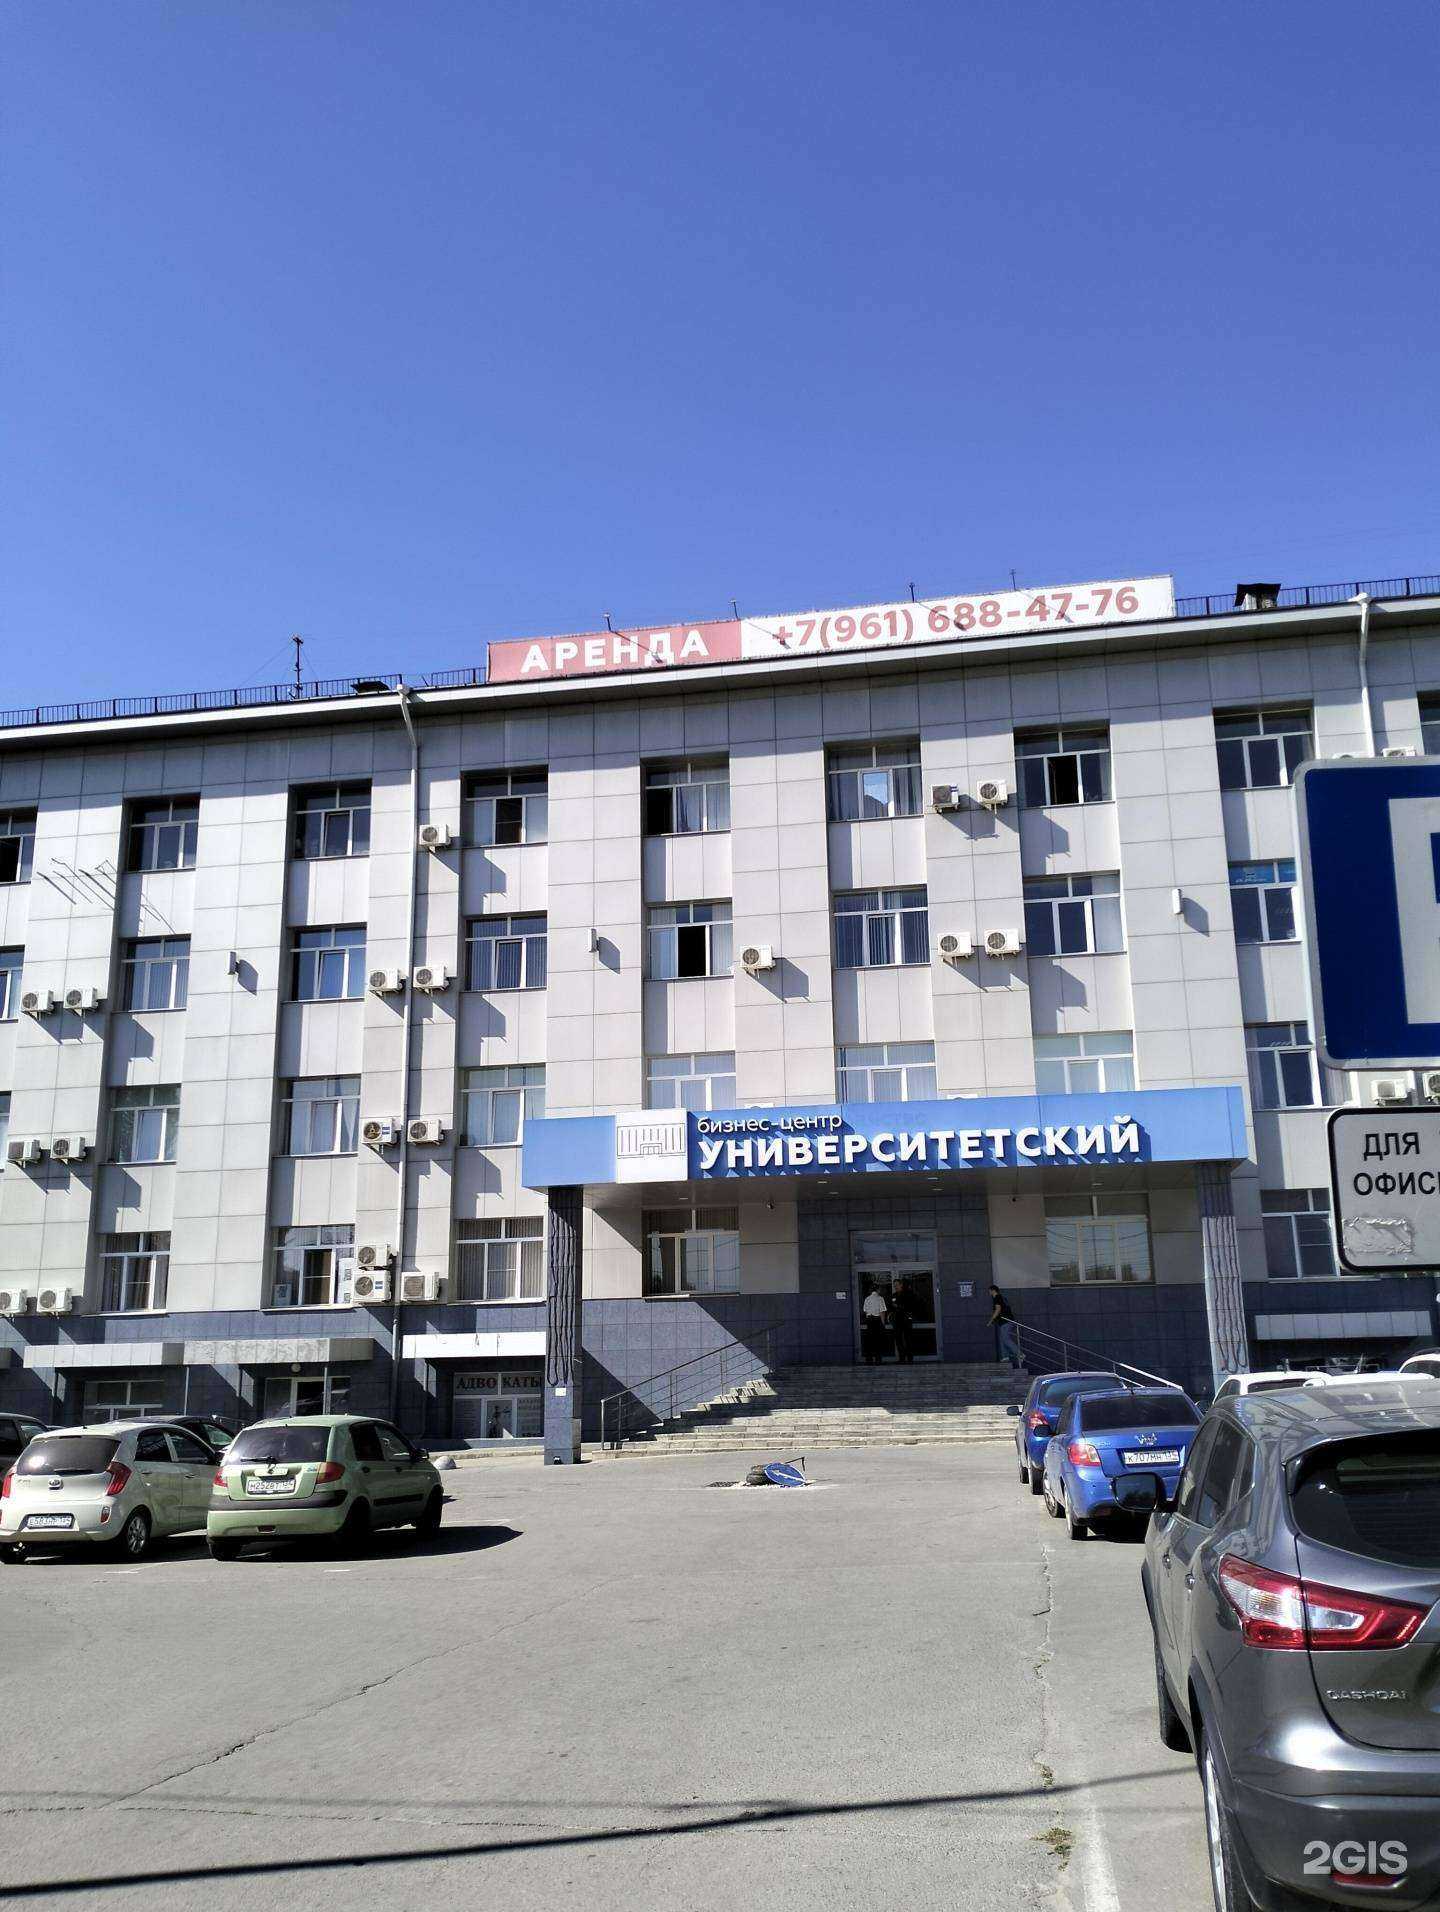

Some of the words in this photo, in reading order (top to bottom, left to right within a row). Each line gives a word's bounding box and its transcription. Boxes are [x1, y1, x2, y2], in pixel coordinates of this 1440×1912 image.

[772, 609, 914, 649] +7(961)
[927, 586, 1140, 634] 688-47-76
[521, 629, 709, 673] АРЕНДА
[697, 1114, 842, 1134] бизнес-центр
[698, 1113, 1140, 1170] УНИВЕРСИТЕТСКИЙ
[1363, 1132, 1420, 1161] ДЛЯ
